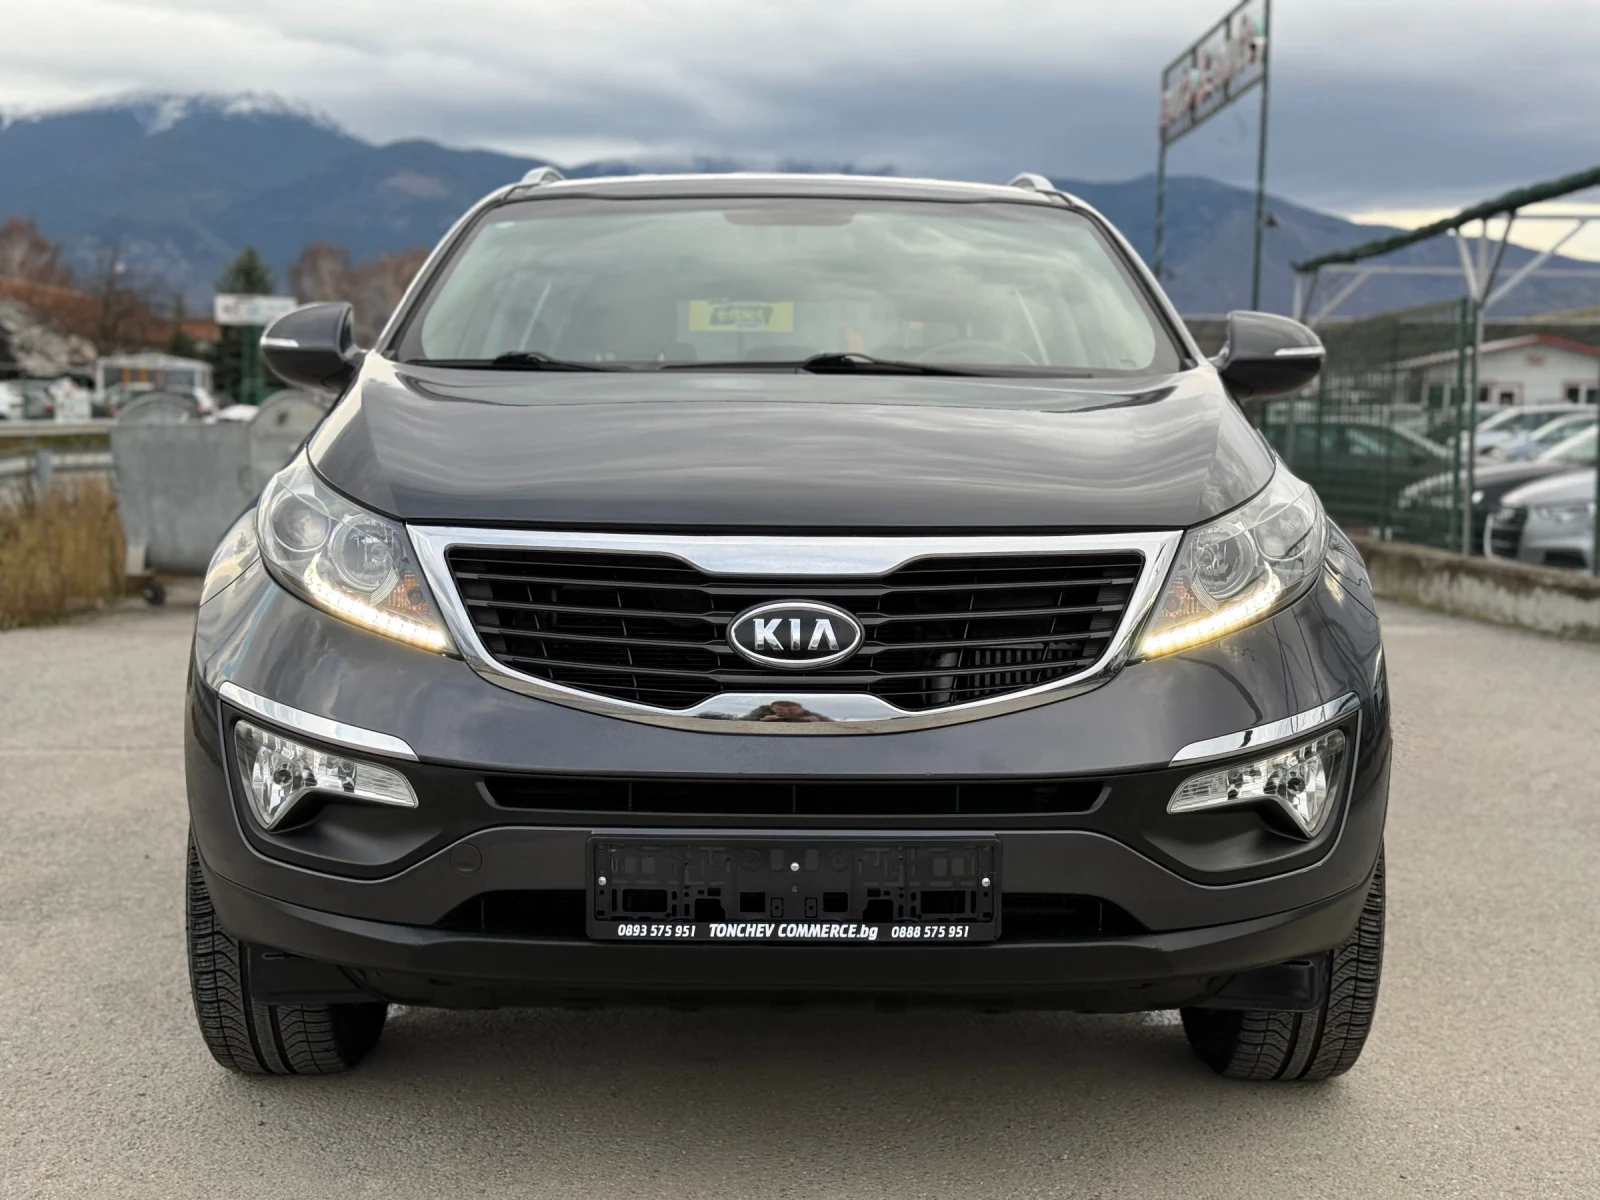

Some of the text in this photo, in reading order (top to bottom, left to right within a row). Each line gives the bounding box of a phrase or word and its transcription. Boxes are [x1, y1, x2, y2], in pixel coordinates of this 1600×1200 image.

[753, 618, 840, 651] KIA
[617, 922, 970, 941] 0893 575 951 TONCHEV COMMERCE.bg 0888 575 951
